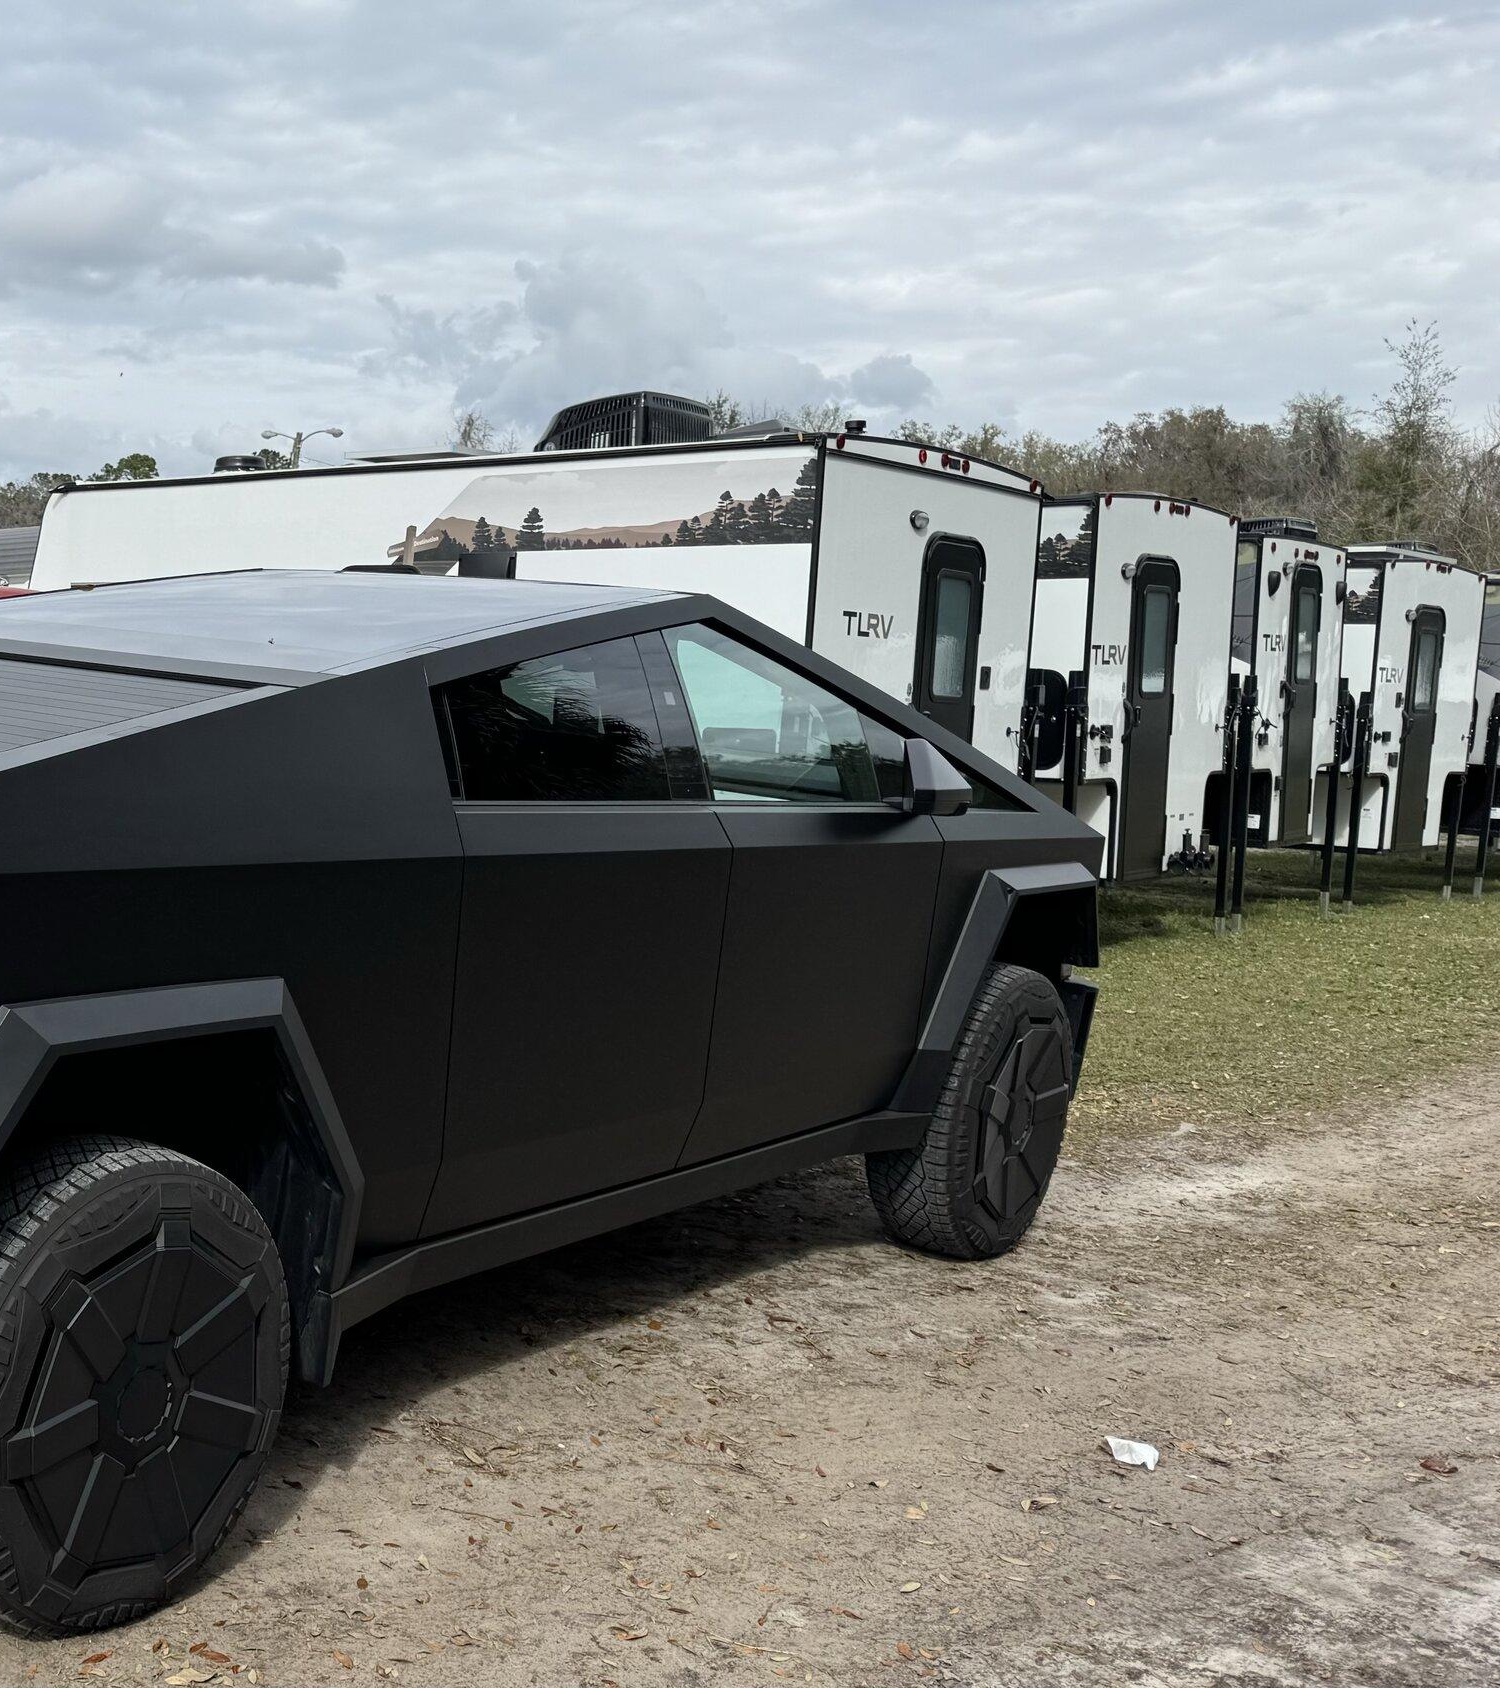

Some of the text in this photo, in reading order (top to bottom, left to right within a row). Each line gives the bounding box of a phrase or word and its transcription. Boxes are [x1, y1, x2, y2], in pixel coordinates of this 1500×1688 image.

[843, 610, 894, 639] TLRV
[1263, 634, 1286, 652] TLRV
[1092, 645, 1127, 665] TLRV
[1379, 667, 1404, 683] TLRV
